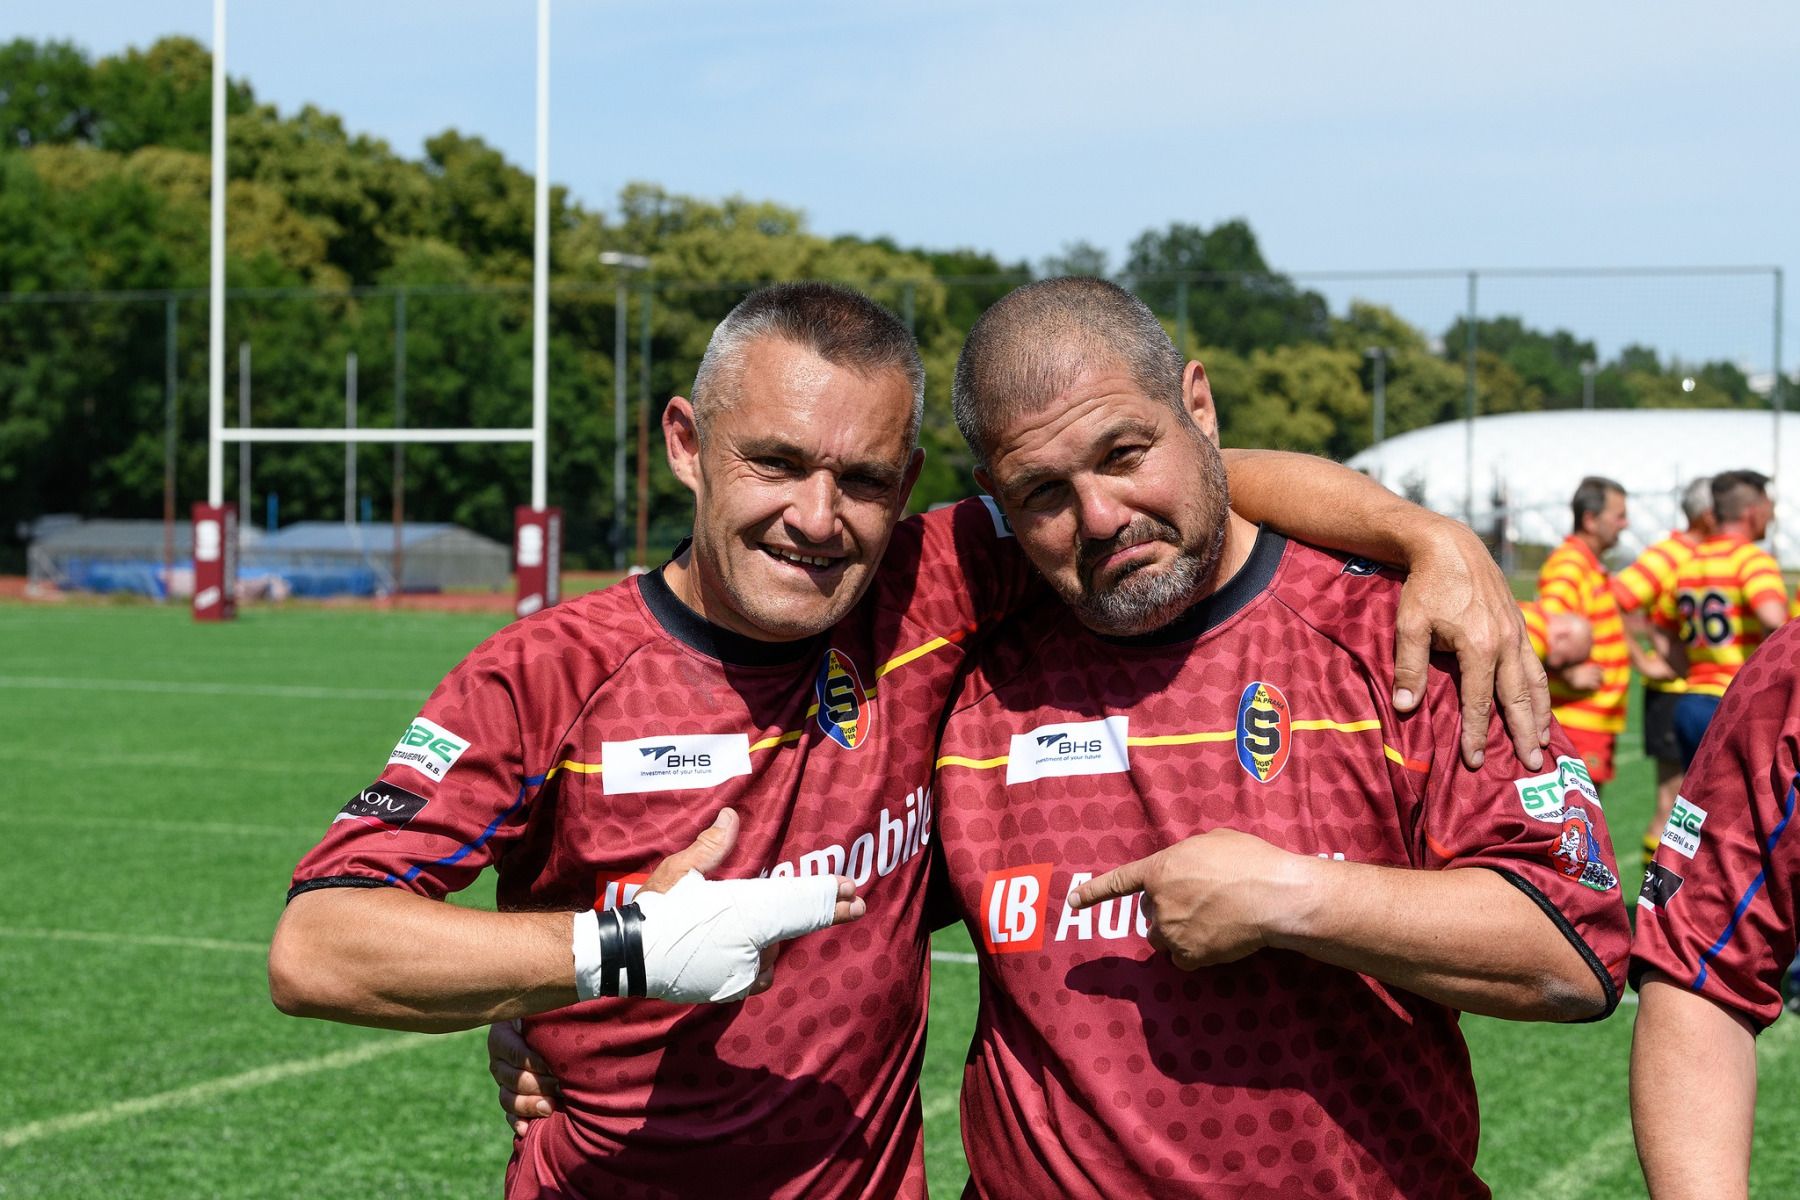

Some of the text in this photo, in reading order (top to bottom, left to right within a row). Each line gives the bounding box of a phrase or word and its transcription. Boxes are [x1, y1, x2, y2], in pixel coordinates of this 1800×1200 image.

[1058, 740, 1102, 755] BHS
[667, 754, 712, 768] BHS
[672, 768, 679, 776] of
[680, 768, 693, 776] your
[988, 875, 1041, 944] LB
